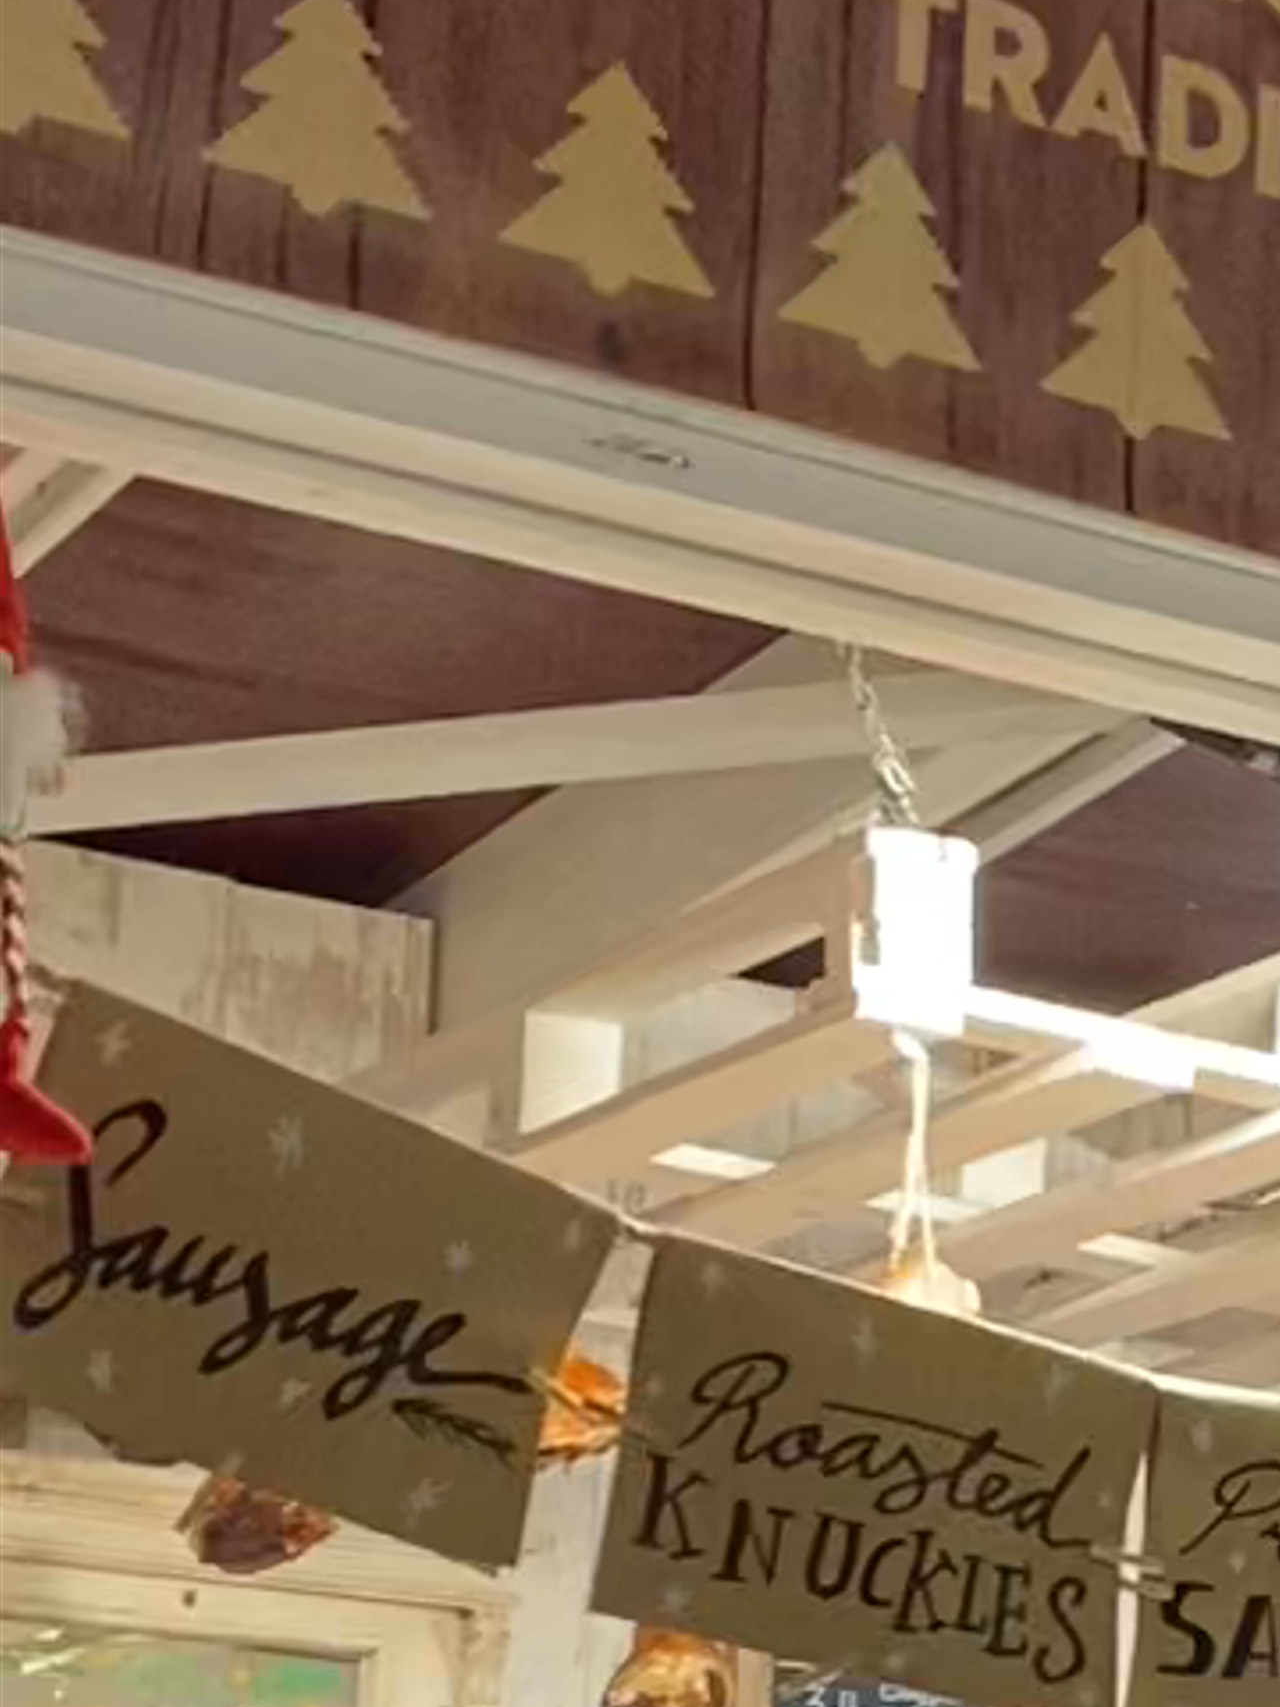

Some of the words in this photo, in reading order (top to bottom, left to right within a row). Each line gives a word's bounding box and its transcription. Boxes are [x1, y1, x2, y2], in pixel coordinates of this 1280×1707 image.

[12, 1099, 532, 1419] Sausage
[690, 1349, 1092, 1549] Roasted
[633, 1451, 1090, 1685] KNUCKLES
